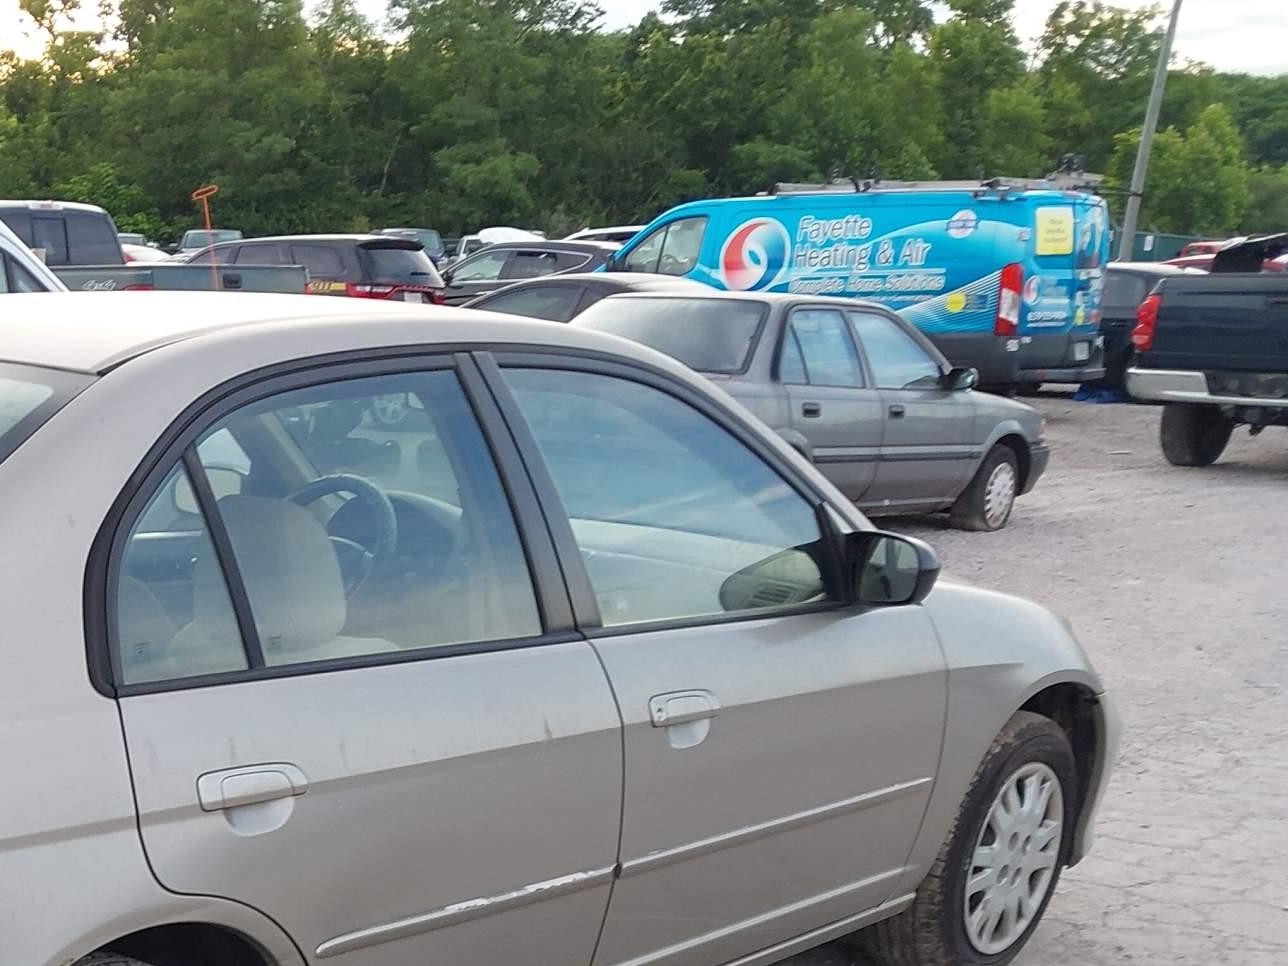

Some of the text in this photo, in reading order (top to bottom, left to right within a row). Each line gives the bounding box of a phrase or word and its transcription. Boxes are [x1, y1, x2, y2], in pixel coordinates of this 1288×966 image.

[798, 215, 871, 245] Fayette
[794, 239, 931, 272] Heating & Air
[885, 274, 945, 290] Solutions
